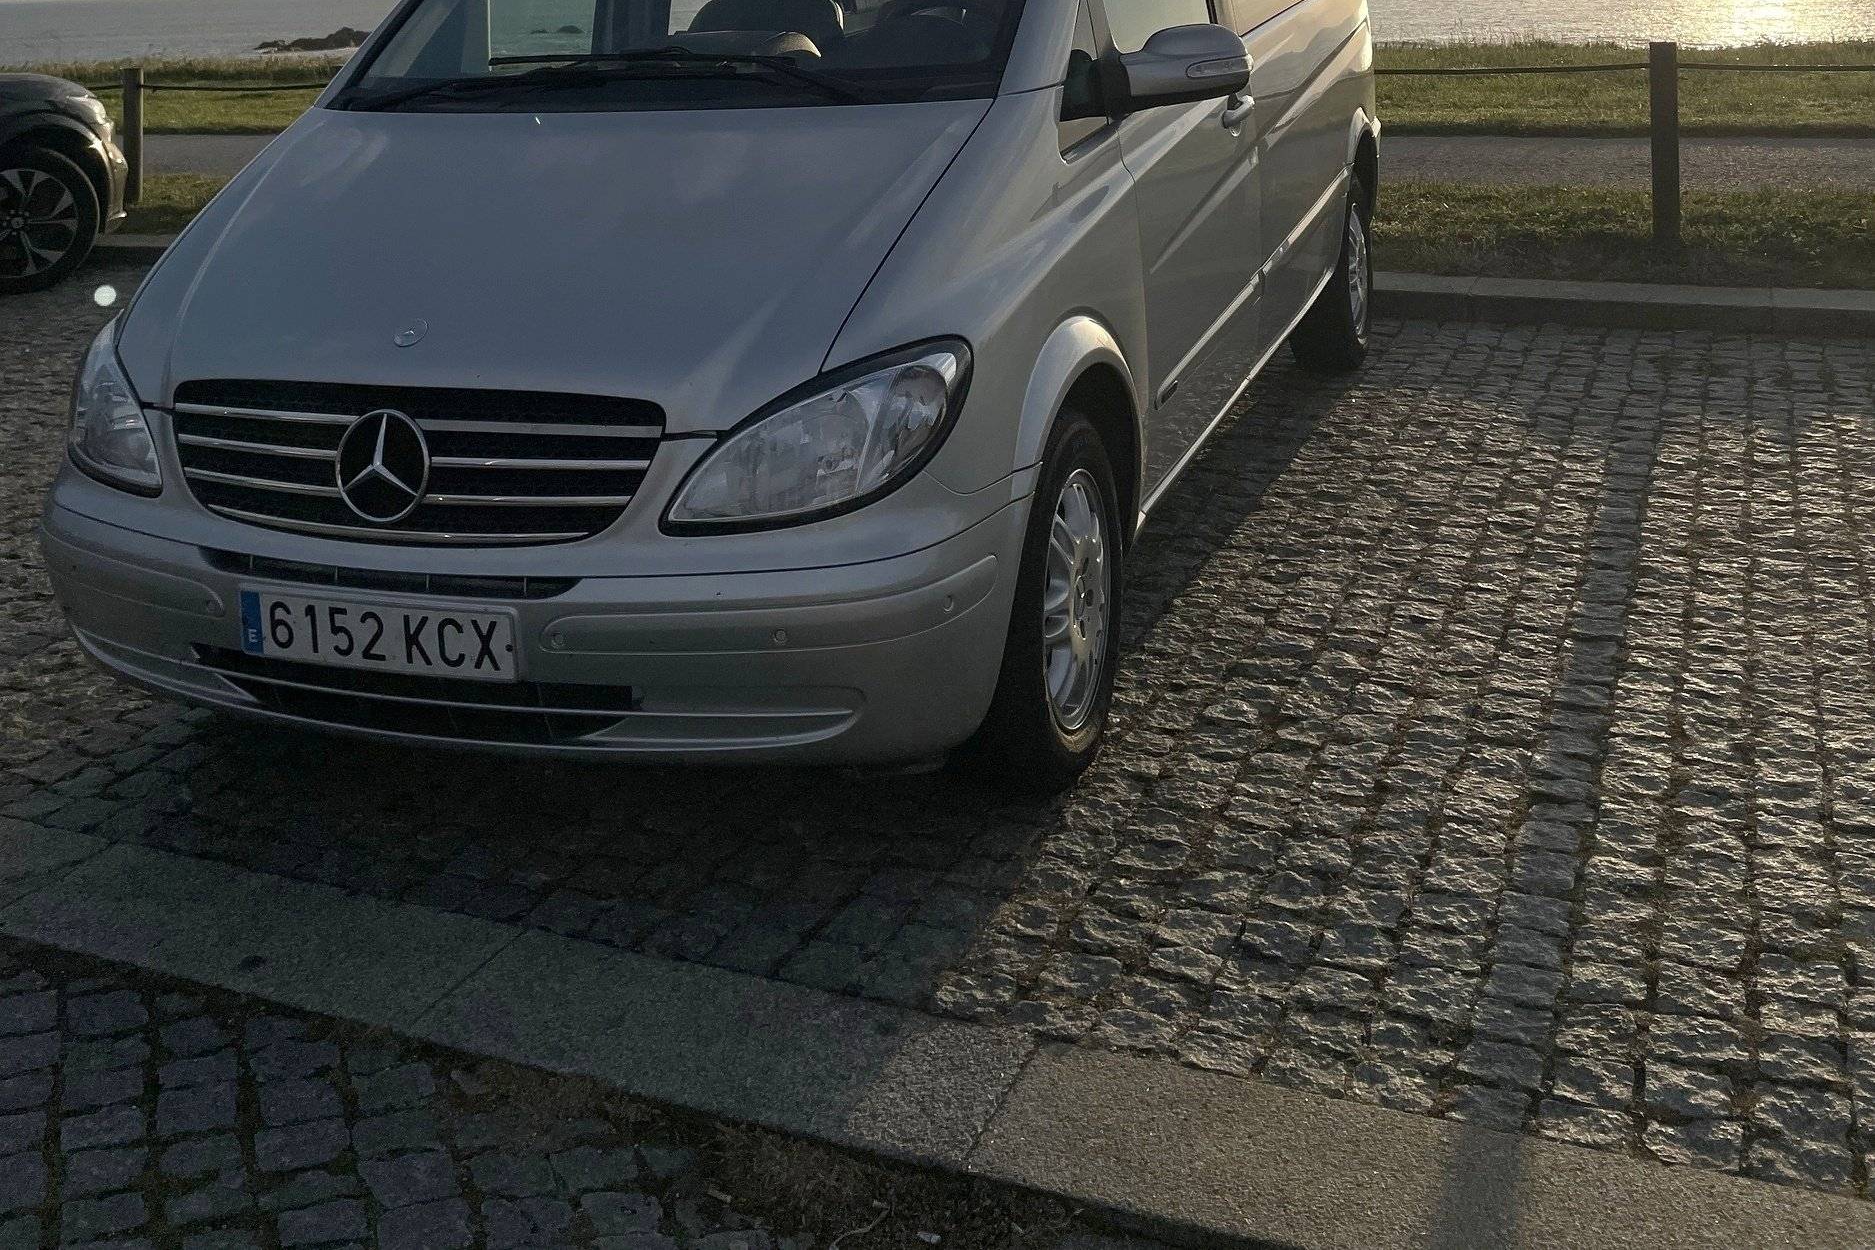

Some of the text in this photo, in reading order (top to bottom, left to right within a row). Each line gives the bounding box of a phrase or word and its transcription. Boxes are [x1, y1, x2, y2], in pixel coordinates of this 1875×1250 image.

[248, 629, 258, 642] E
[269, 601, 501, 671] 6152 KCX
